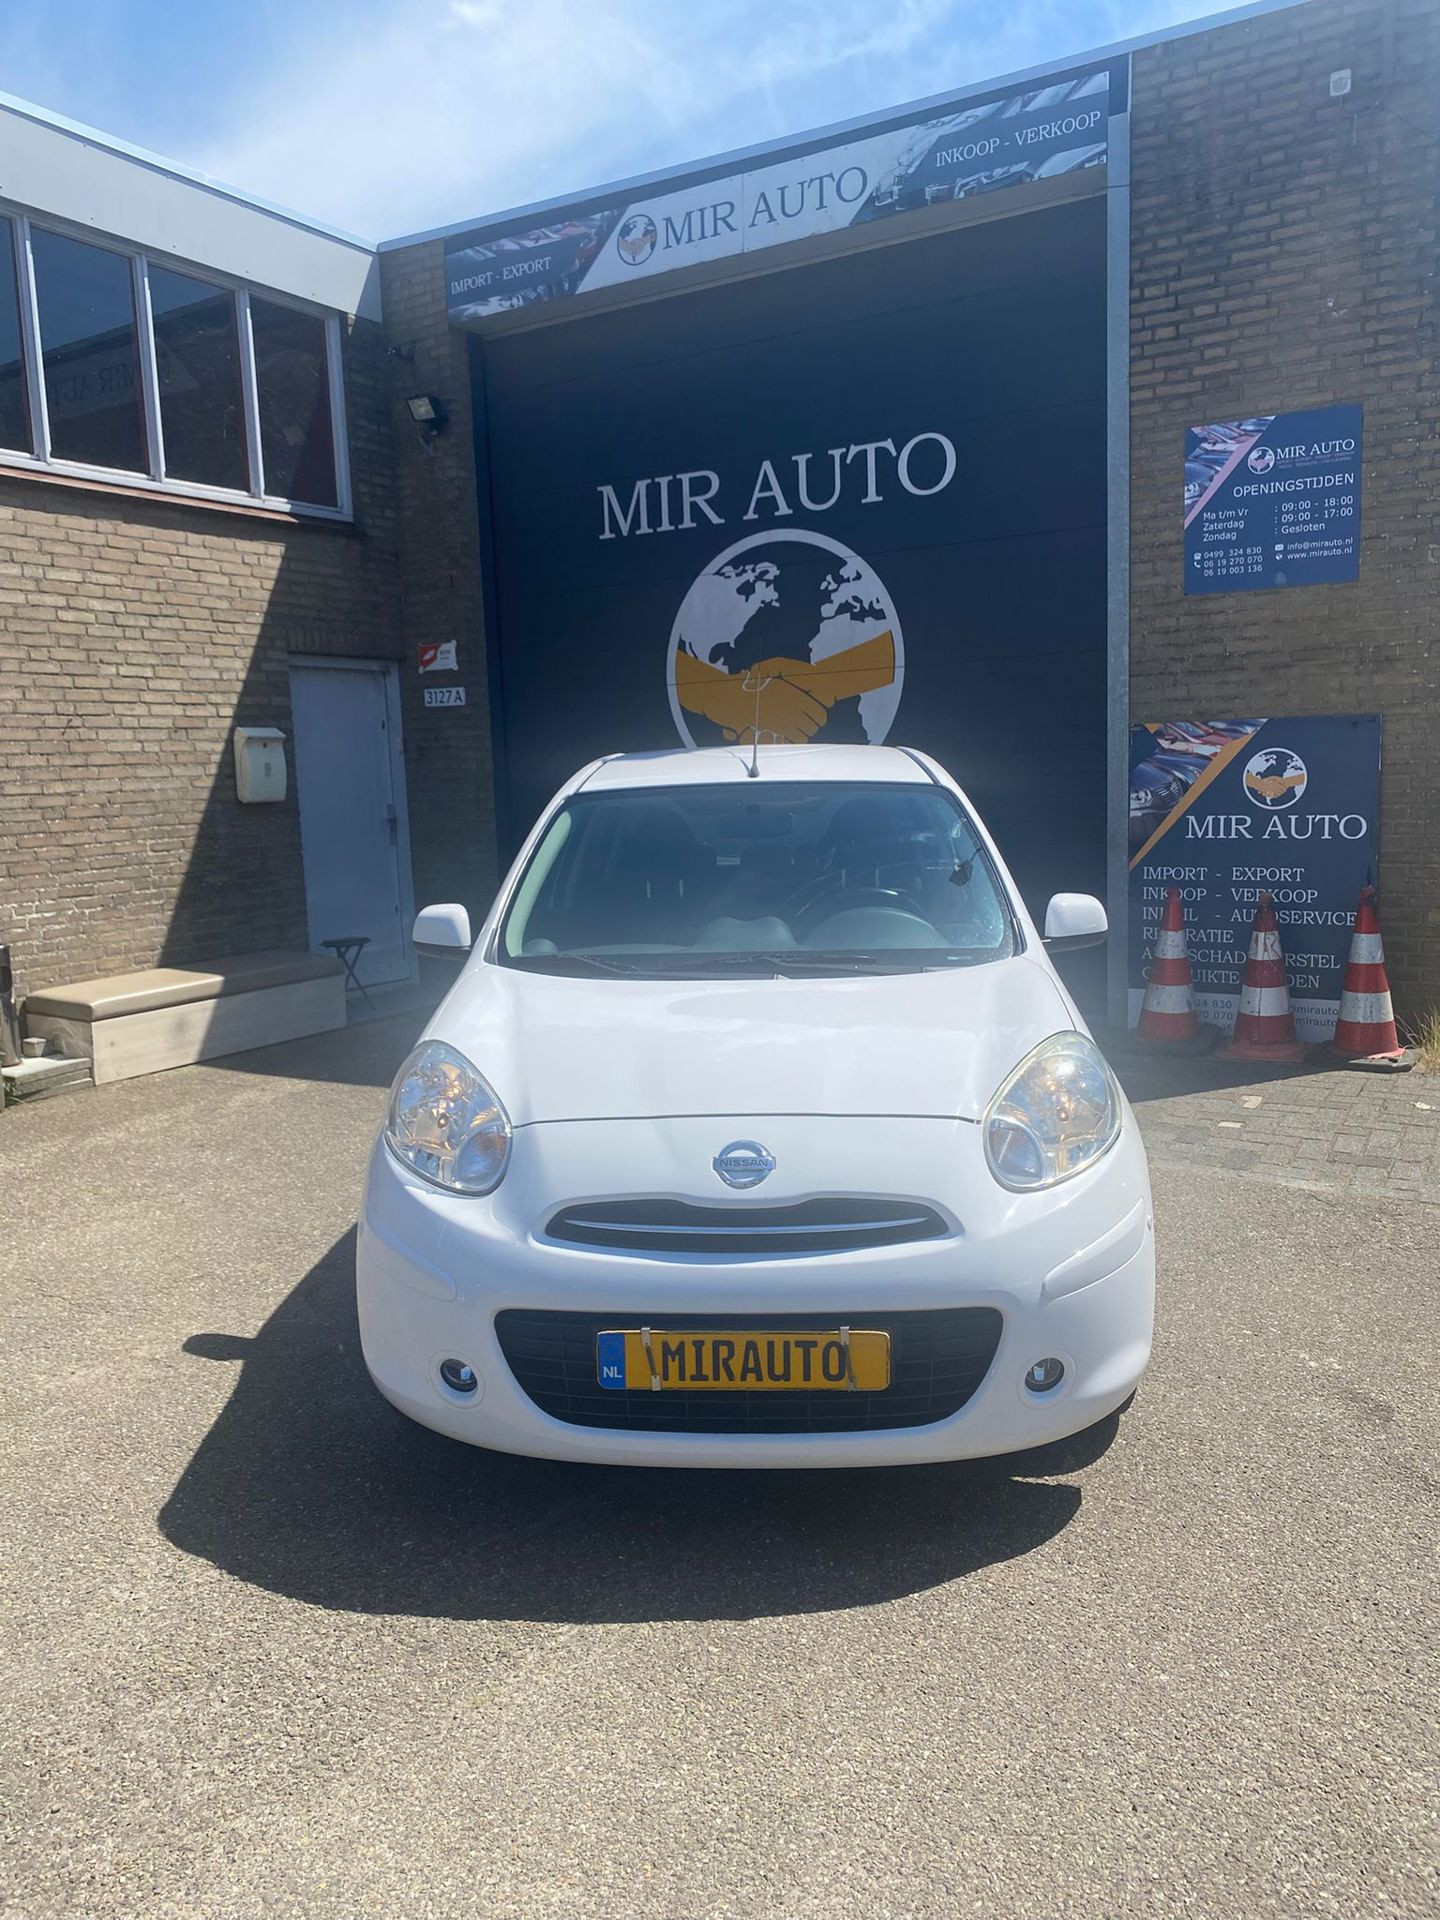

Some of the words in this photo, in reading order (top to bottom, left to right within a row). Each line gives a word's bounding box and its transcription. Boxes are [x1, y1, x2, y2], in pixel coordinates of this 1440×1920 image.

[936, 137, 1000, 167] INKOOP
[1015, 110, 1101, 147] VERKOOP
[662, 200, 738, 250] MIR
[748, 166, 868, 229] AUTO
[451, 271, 493, 295] IMPORT
[503, 256, 552, 280] EXPORT
[1276, 444, 1306, 460] MIR
[1310, 438, 1355, 456] AUTO
[596, 468, 725, 540] MIR
[742, 432, 957, 521] AUTO
[1233, 472, 1355, 498] OPENINGSTIJDEN
[1203, 511, 1216, 521] Ma
[1219, 509, 1236, 519] t/m
[1237, 507, 1249, 517] Vr
[1281, 500, 1311, 512] 09:00
[1324, 495, 1354, 507] 18:00
[1203, 519, 1245, 531] Zaterdag
[1281, 511, 1311, 523] 09:00
[1324, 507, 1354, 519] 17:00
[1203, 531, 1238, 542] Zondag
[1281, 522, 1326, 534] Gesloten
[1203, 550, 1224, 559] 0499
[1229, 548, 1244, 557] 324
[1246, 546, 1262, 555] 830
[1287, 537, 1353, 551] info@mirauto.nl
[1287, 546, 1353, 560] www.mirauto.nl
[1203, 560, 1214, 568] 06
[1229, 556, 1245, 566] 270
[1247, 555, 1263, 564] 070
[1203, 568, 1214, 577] 06
[1185, 815, 1254, 840] MIR
[1262, 814, 1368, 840] AUTO
[1143, 866, 1208, 880] IMPORT
[1232, 867, 1305, 882] EXPORT
[1230, 908, 1358, 926] AUSERVICE
[719, 1157, 769, 1168] NISSAN
[603, 1366, 623, 1379] NL
[661, 1339, 848, 1382] MIRAUTO
